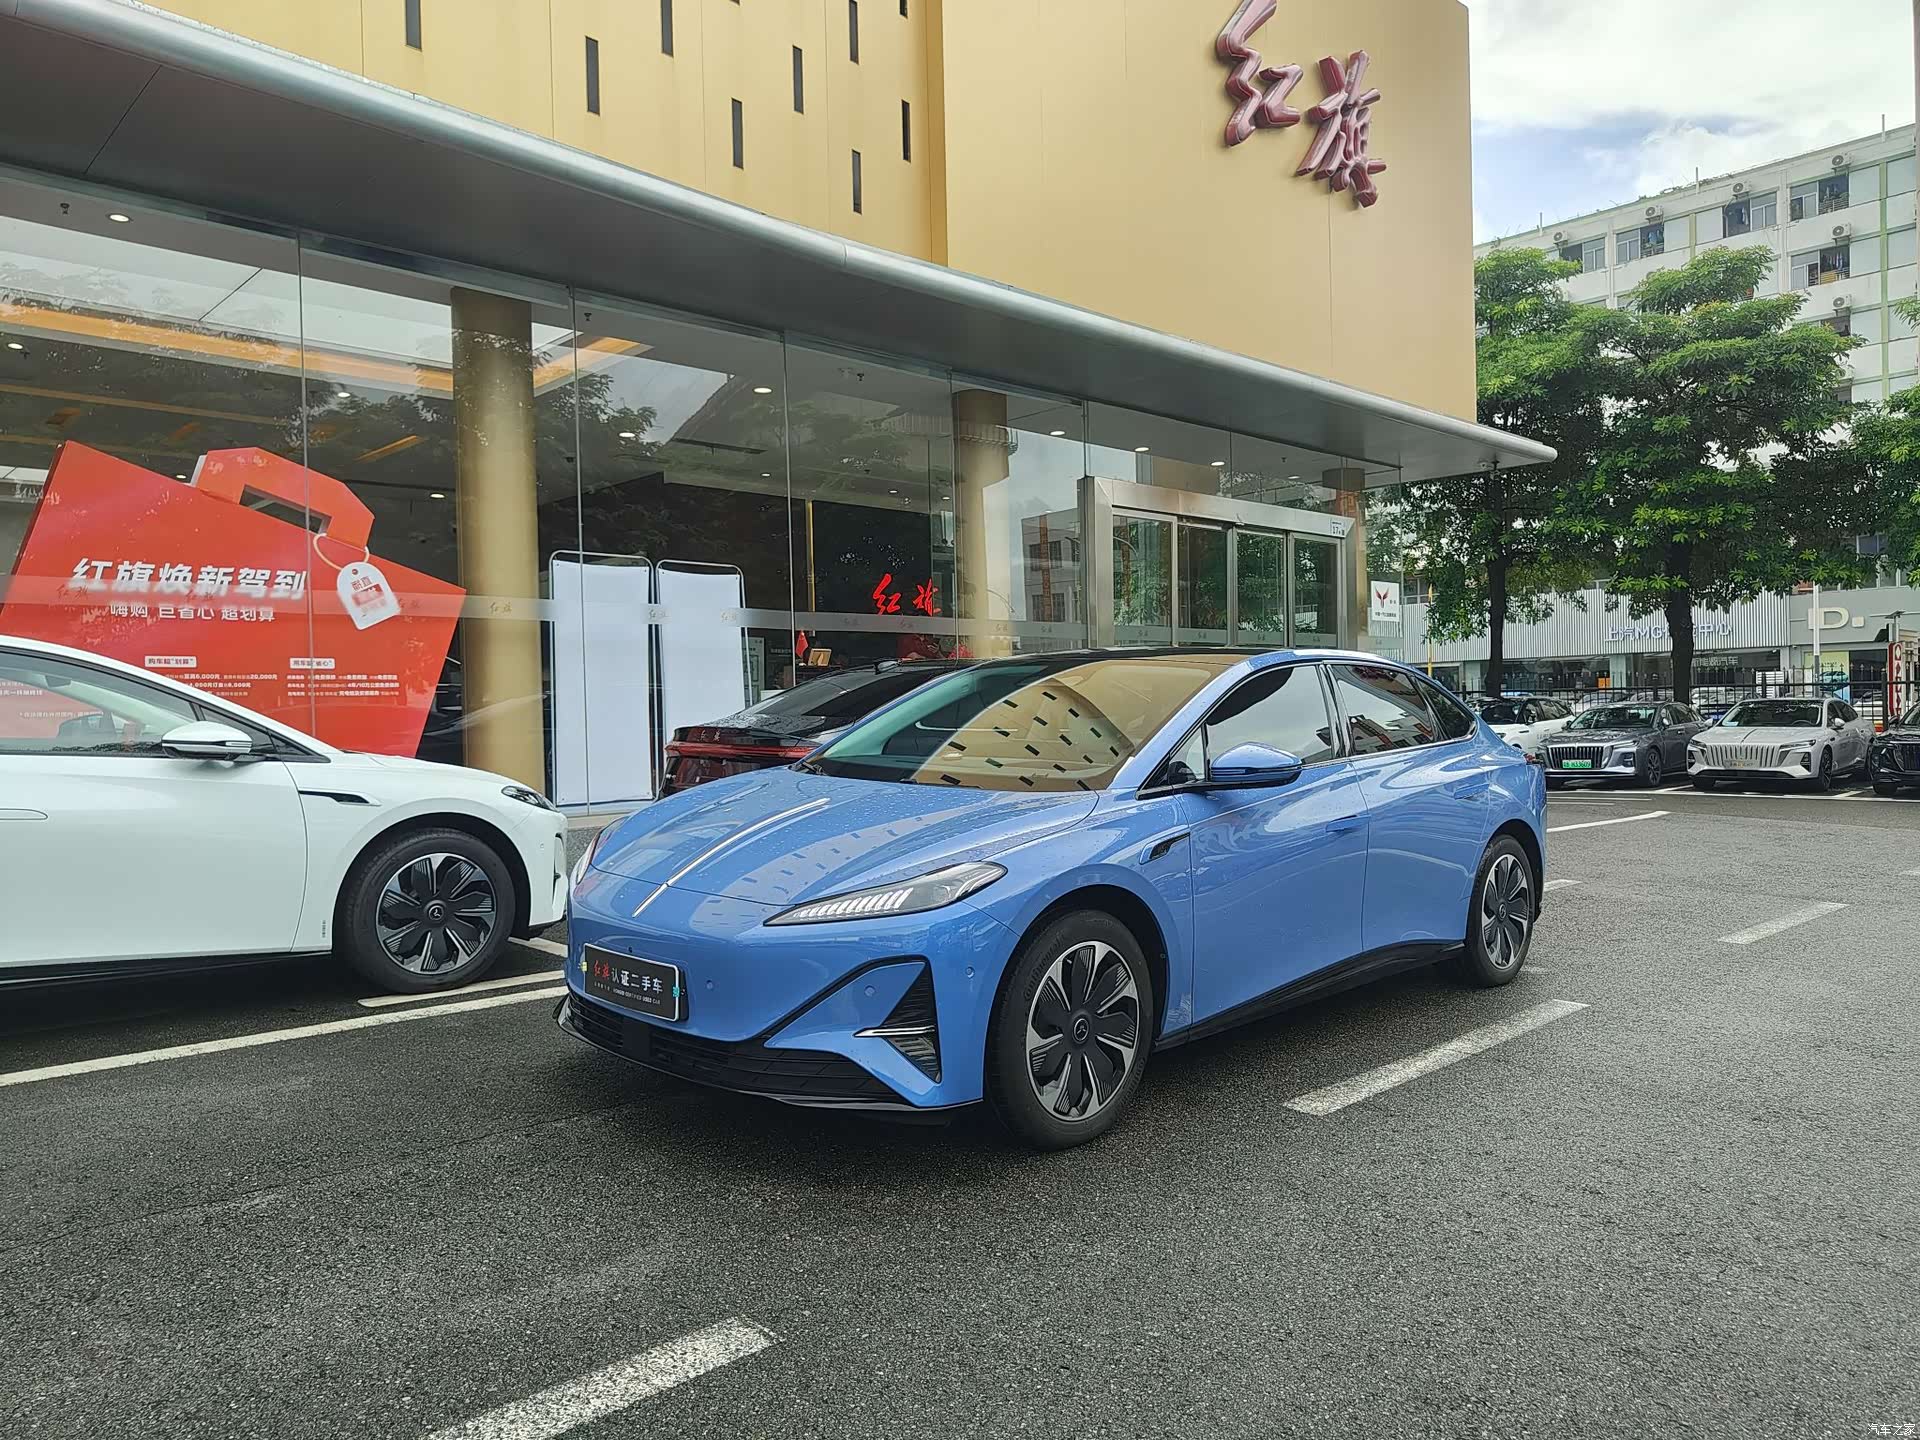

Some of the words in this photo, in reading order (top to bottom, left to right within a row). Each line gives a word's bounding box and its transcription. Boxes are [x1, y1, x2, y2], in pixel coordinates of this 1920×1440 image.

[1215, 0, 1387, 207] 红旗
[68, 557, 308, 600] 红旗焕新驾到
[220, 606, 275, 622] 超划算
